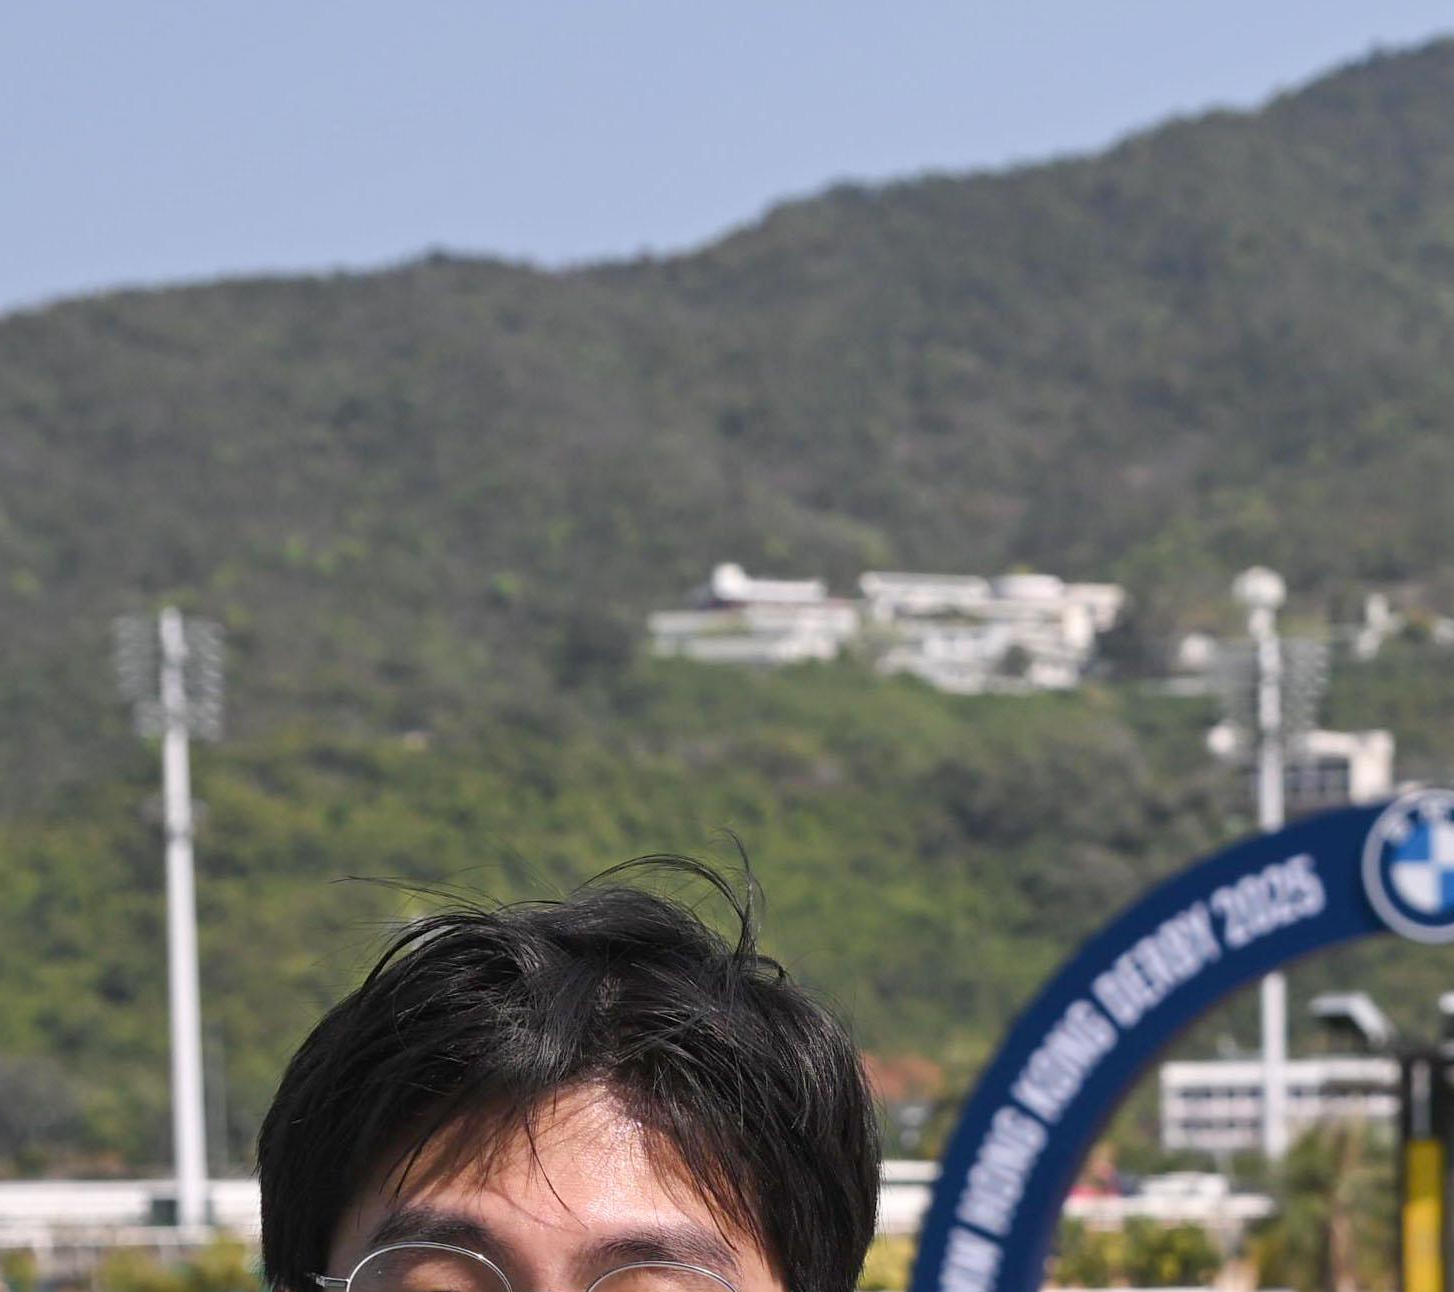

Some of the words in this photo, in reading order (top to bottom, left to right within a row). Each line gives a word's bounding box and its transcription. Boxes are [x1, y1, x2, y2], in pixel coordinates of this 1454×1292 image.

[955, 1104, 1048, 1237] HONG
[1010, 999, 1119, 1126] KONG
[1090, 899, 1222, 1029] DERBY
[1209, 852, 1326, 948] 2025
